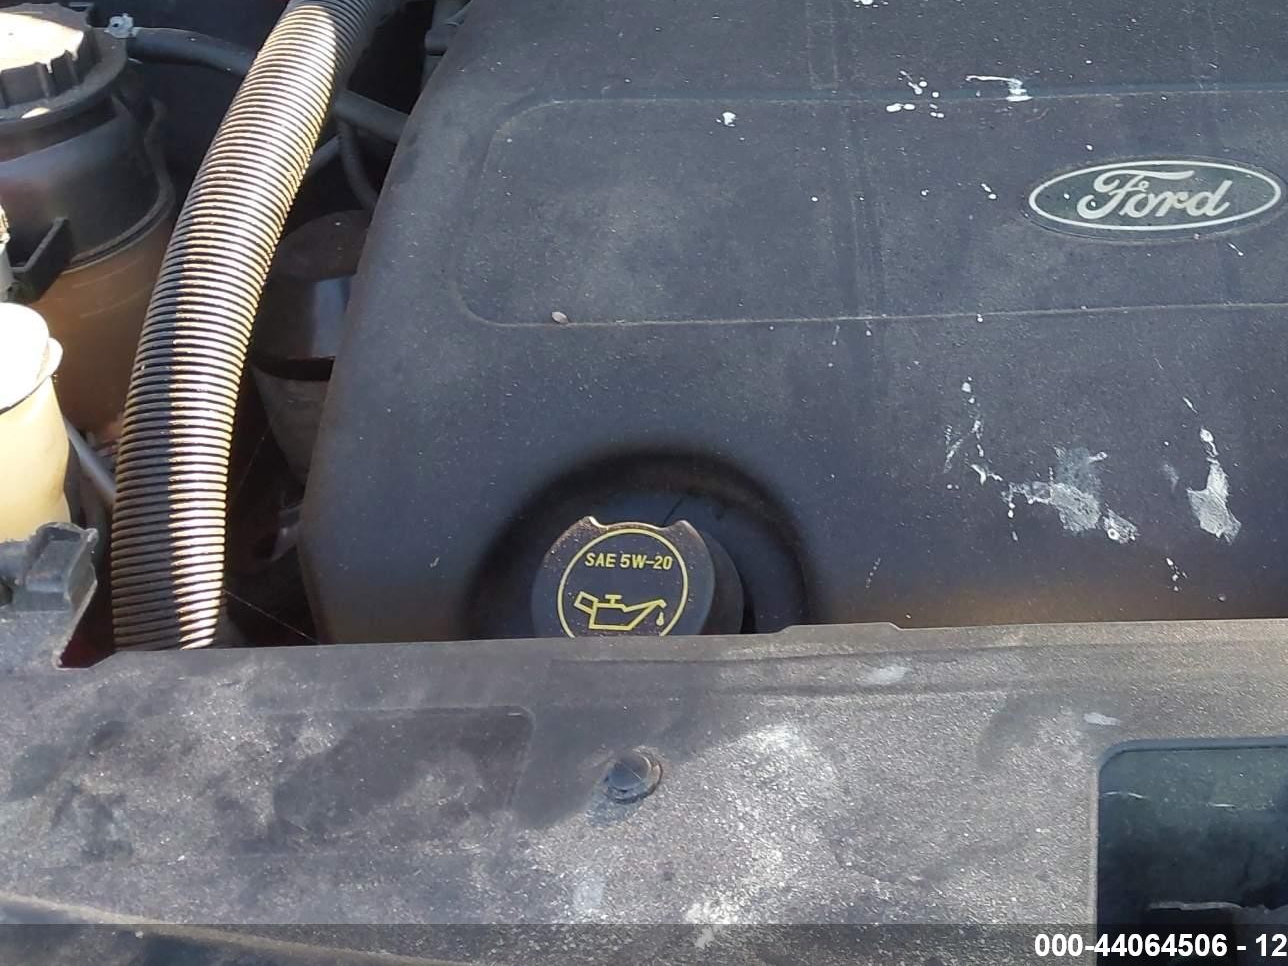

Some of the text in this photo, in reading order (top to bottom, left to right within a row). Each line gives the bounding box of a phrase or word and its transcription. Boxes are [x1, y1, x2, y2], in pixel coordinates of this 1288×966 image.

[1076, 168, 1233, 220] Ford
[584, 552, 674, 570] SAE 5W-20
